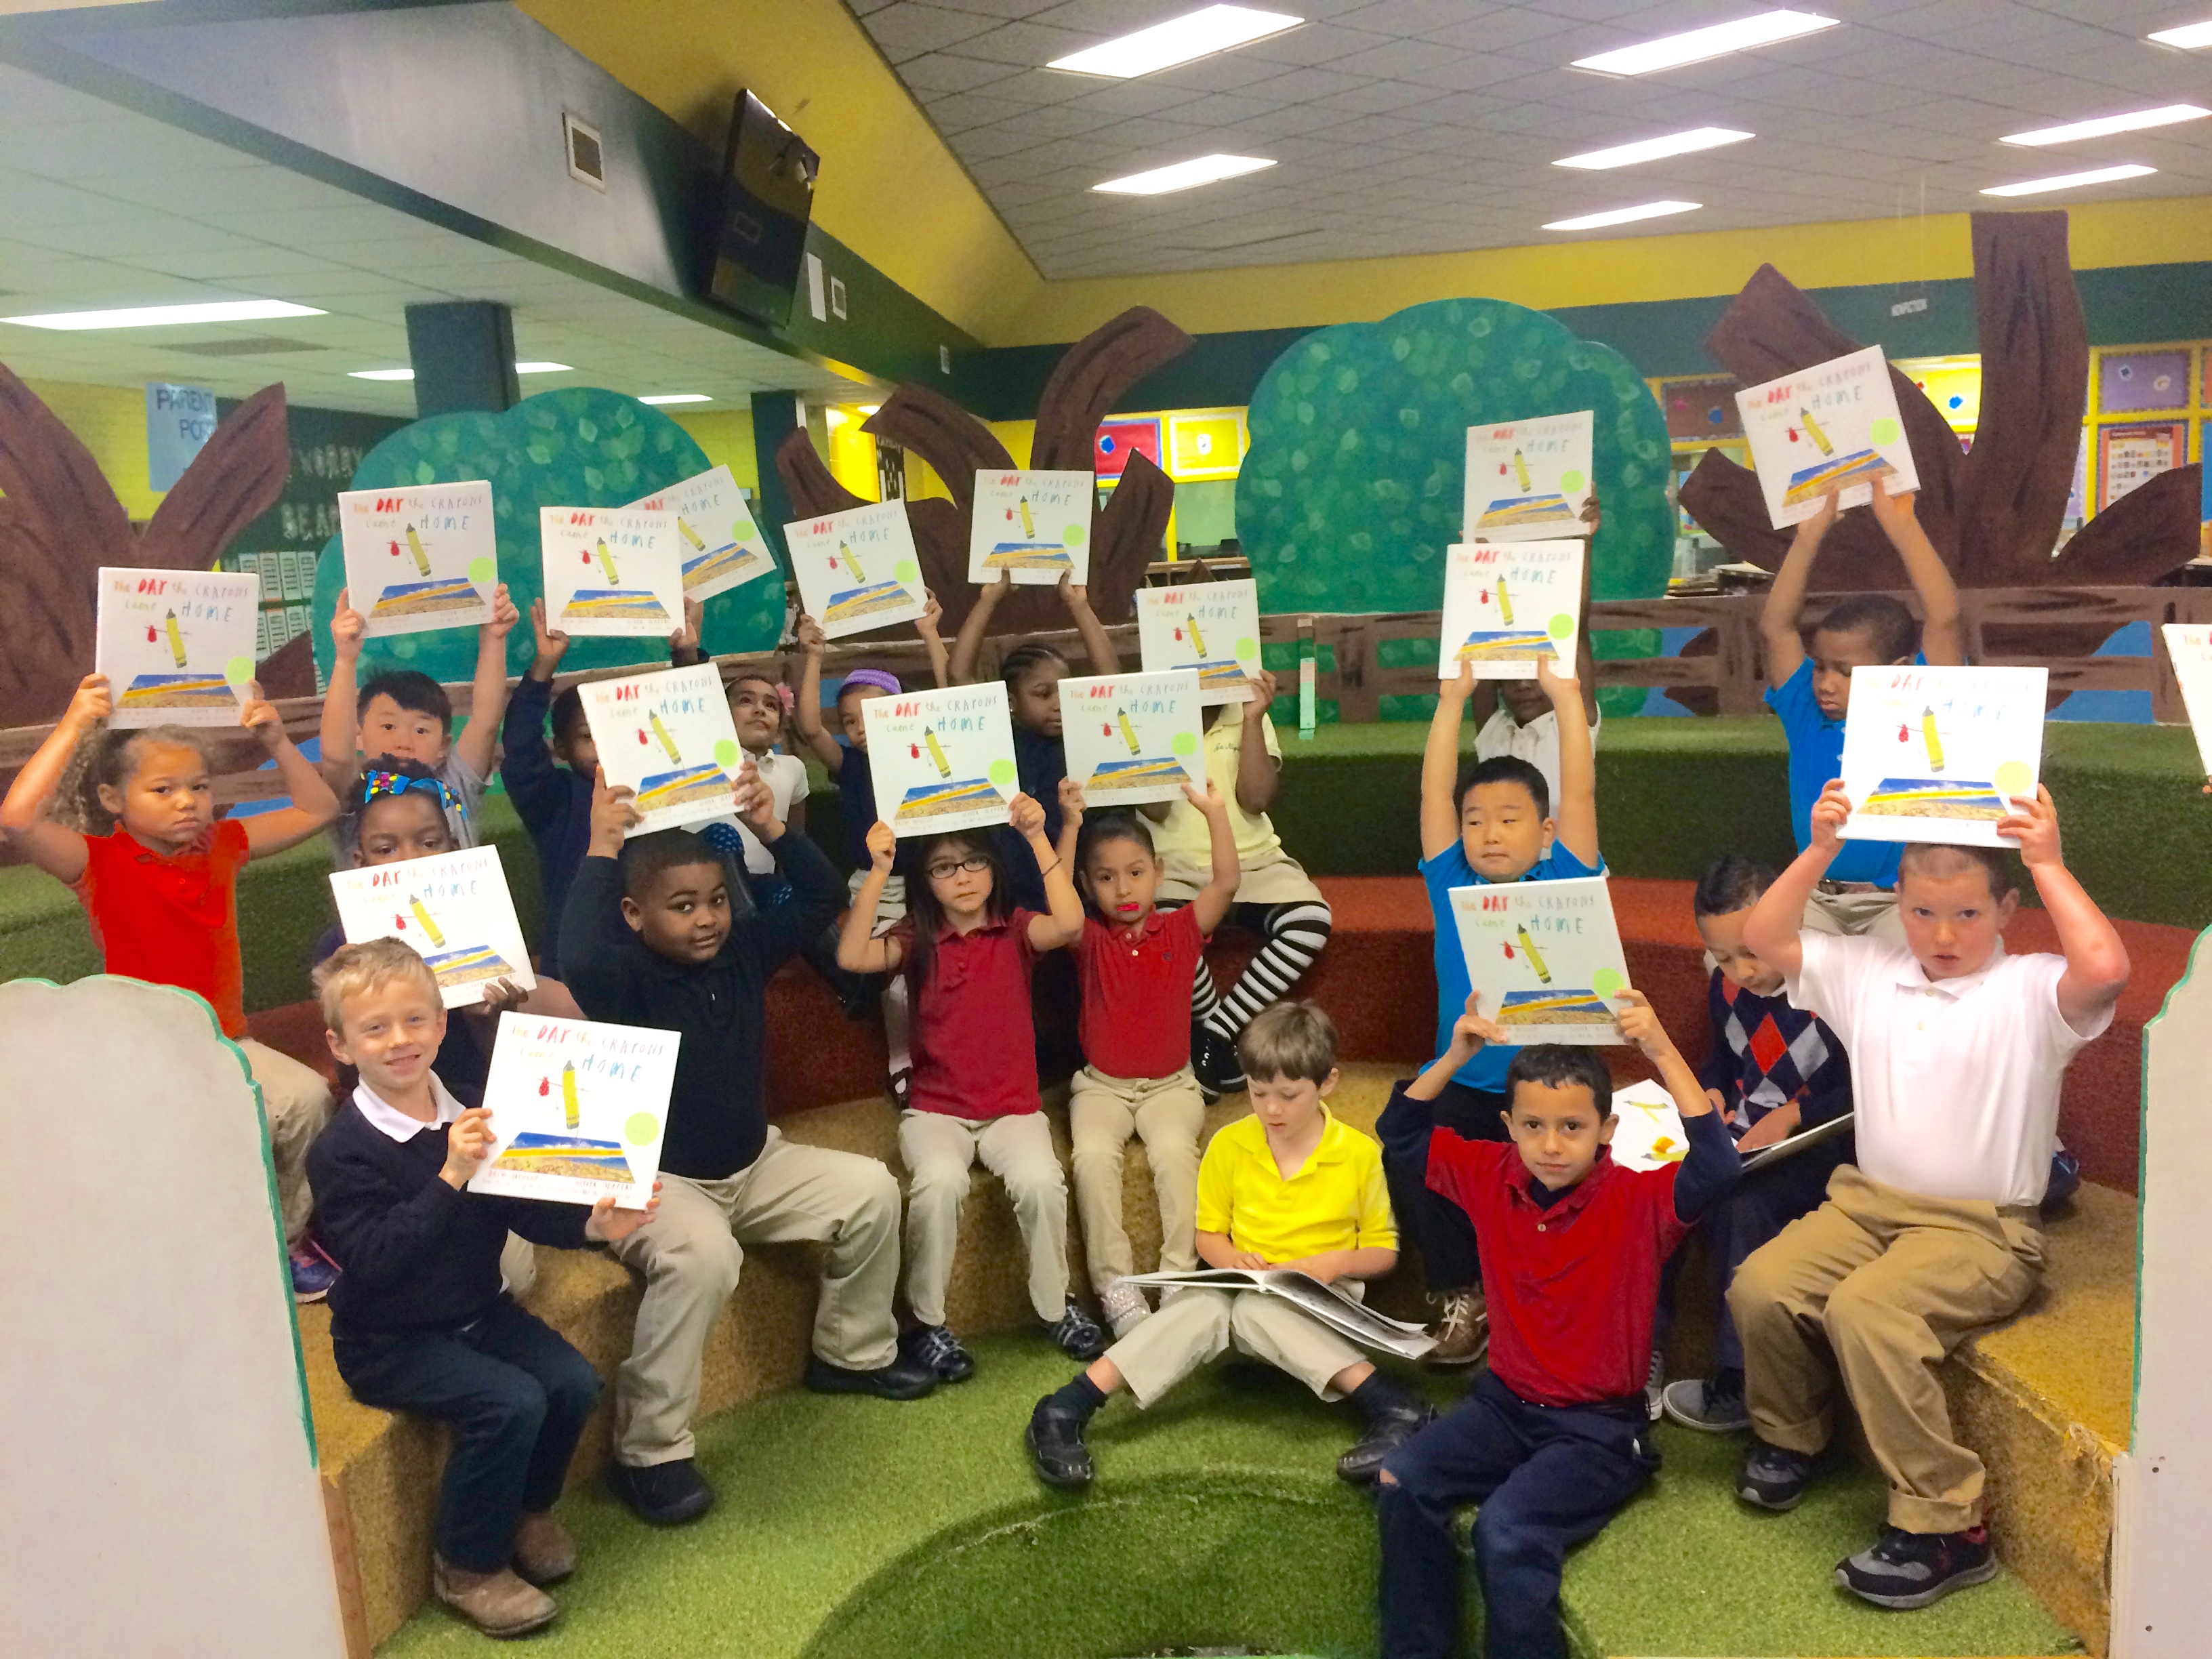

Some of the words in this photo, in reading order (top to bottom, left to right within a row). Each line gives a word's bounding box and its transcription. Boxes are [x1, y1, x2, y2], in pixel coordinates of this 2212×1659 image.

[1812, 386, 1861, 409] HOME
[1000, 475, 1021, 487] DAY
[376, 498, 404, 513] DAY
[432, 495, 482, 510] CRAYONS
[682, 494, 720, 515] HOME
[1032, 490, 1071, 506] HOME
[420, 514, 469, 530] HOME
[571, 512, 595, 527] DAY
[621, 519, 667, 529] CRAYONS
[813, 520, 834, 534] DAY
[611, 531, 656, 548] HOME
[850, 528, 889, 544] HOME
[1475, 550, 1499, 564] DAY
[1511, 567, 1557, 584] HOME
[138, 579, 167, 595] DAY
[196, 586, 249, 598] CRAYONS
[182, 601, 233, 622] HOME
[1199, 605, 1238, 619] HOME
[617, 684, 640, 701] DAY
[666, 677, 712, 693] CRAYONS
[1070, 690, 1084, 699] The
[1090, 685, 1115, 699] DAY
[1120, 685, 1133, 695] the
[1141, 682, 1189, 695] CRAYONS
[661, 698, 705, 714] HOME
[874, 709, 889, 718] The
[895, 702, 921, 717] DAY
[926, 701, 940, 712] the
[947, 695, 997, 712] CRAYONS
[1131, 699, 1176, 714] HOME
[938, 716, 985, 732] HOME
[373, 870, 401, 886] DAY
[432, 859, 488, 877] CRAYONS
[424, 880, 476, 898] HOME
[1483, 895, 1508, 912] DAY
[1531, 915, 1583, 934] HOME
[513, 1025, 528, 1038] The
[537, 1024, 571, 1044] DAY
[602, 1037, 664, 1055] CRAYONS
[582, 1054, 642, 1082] HOME
